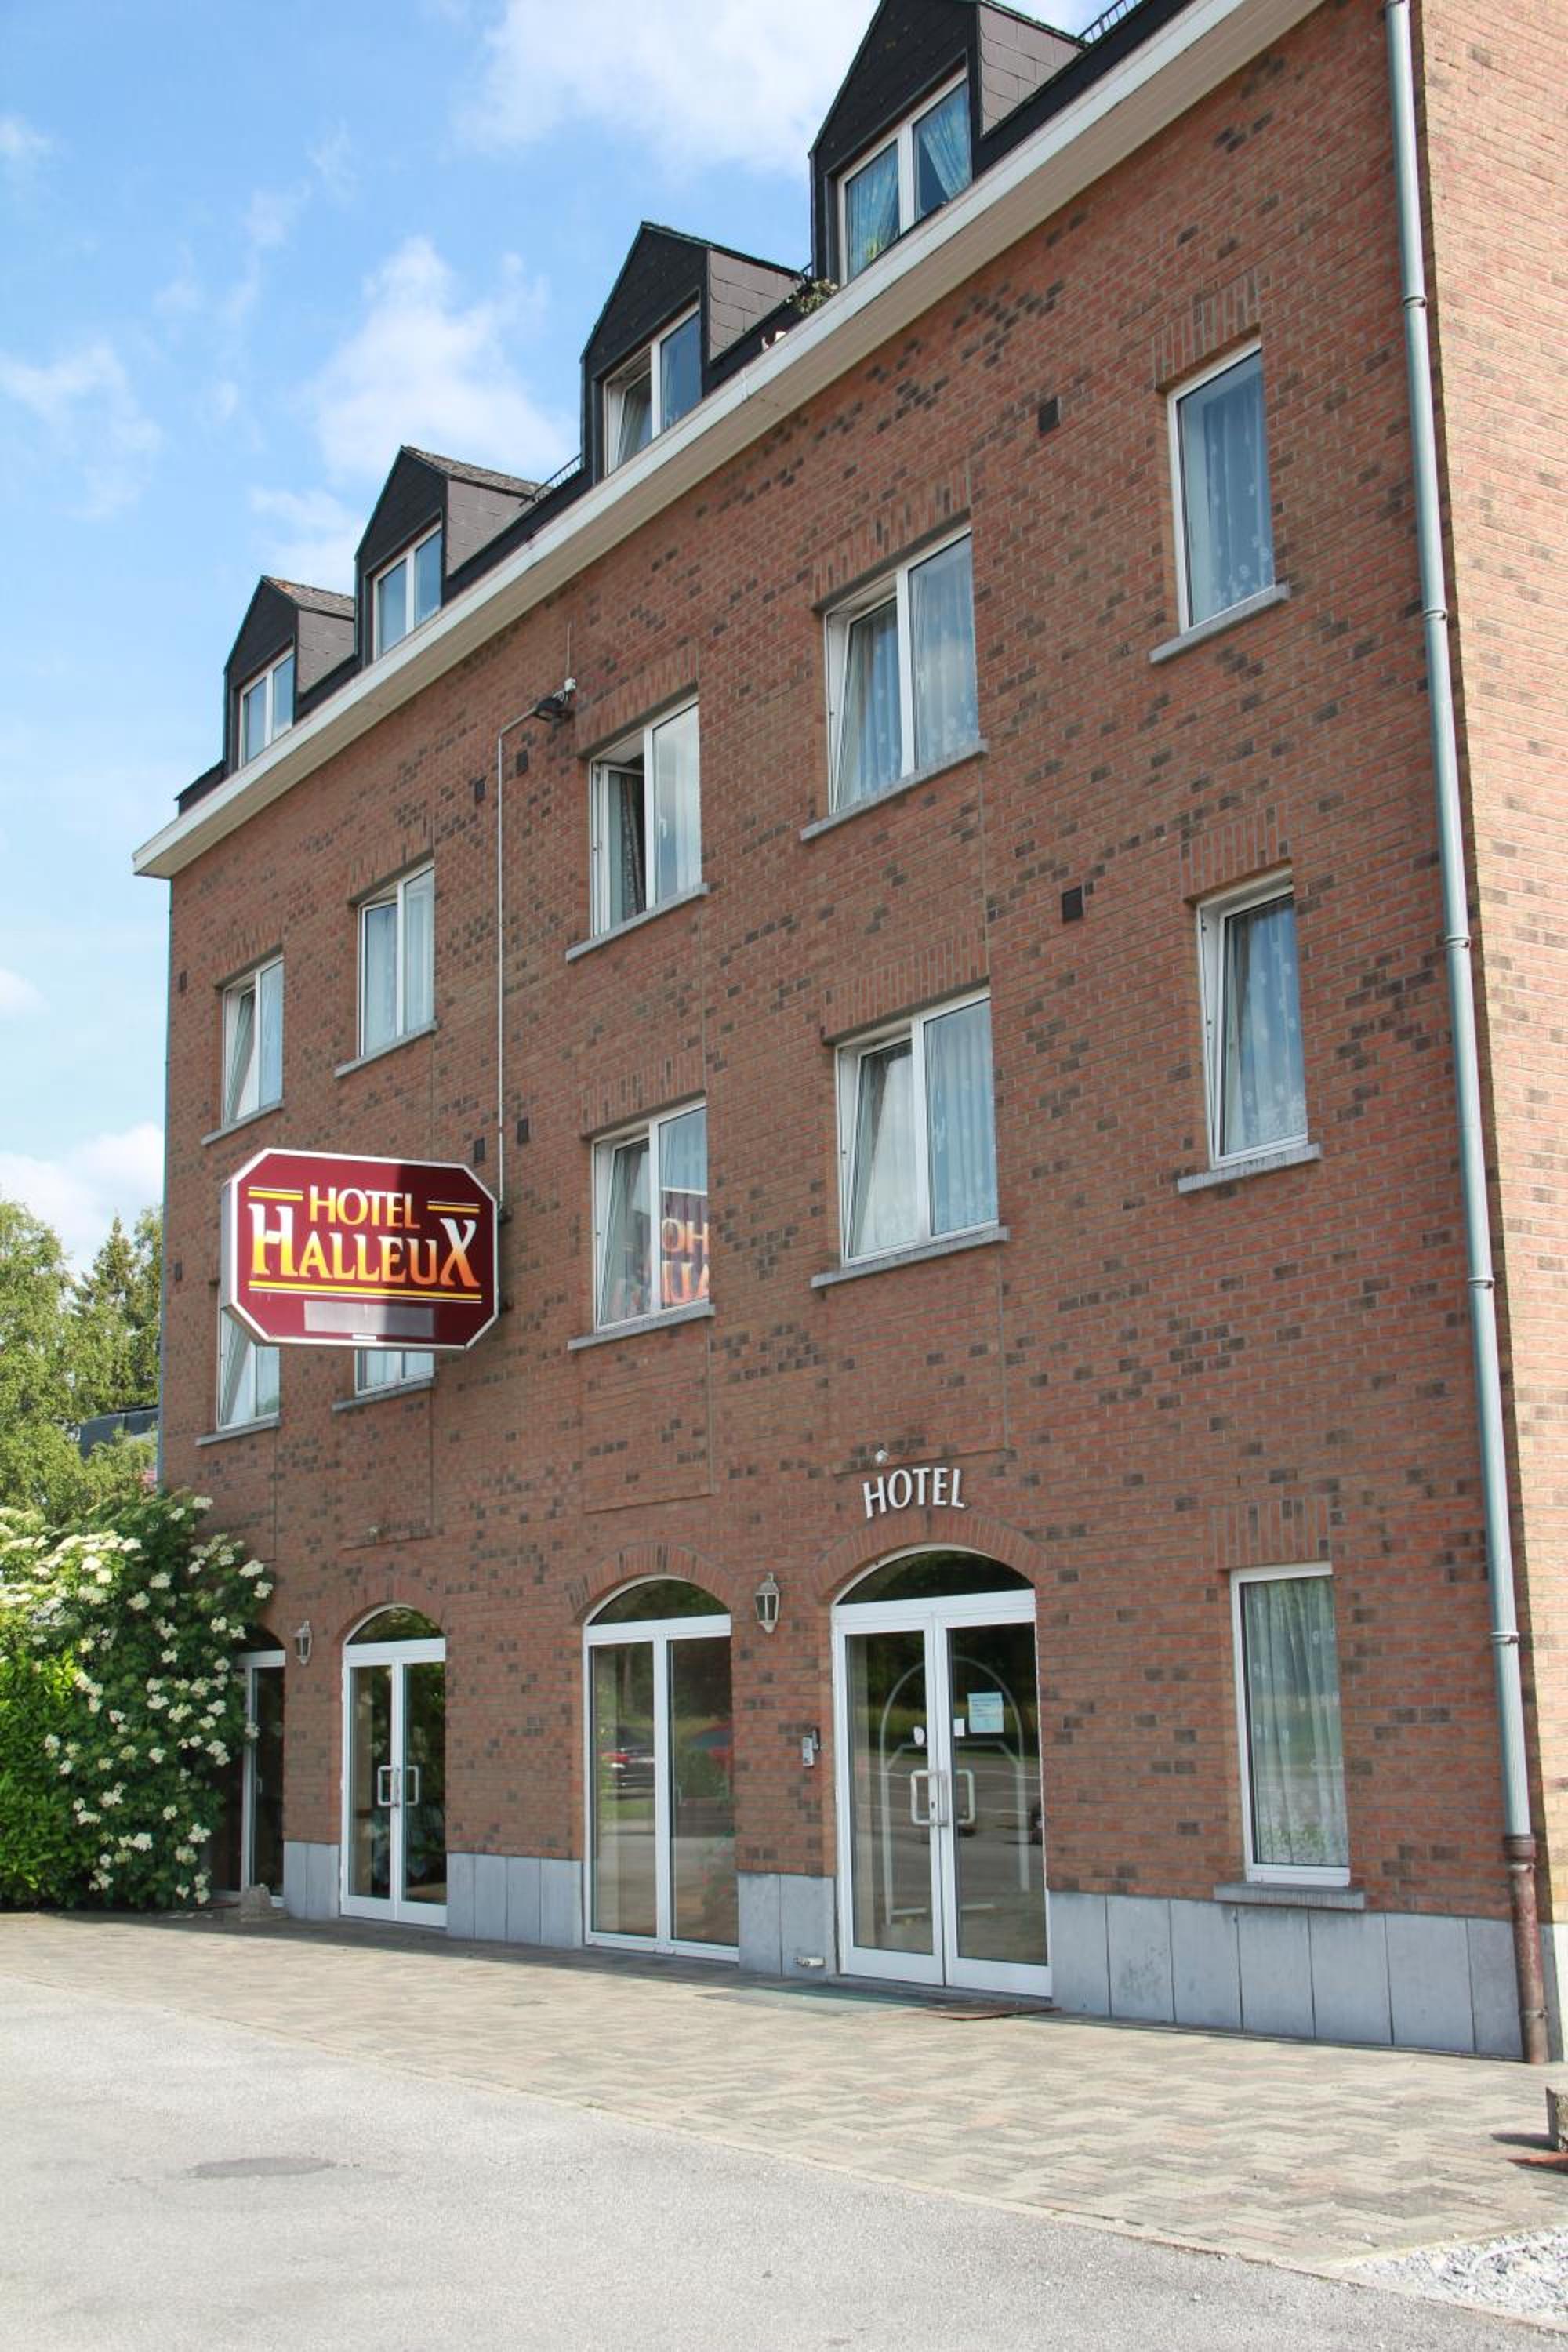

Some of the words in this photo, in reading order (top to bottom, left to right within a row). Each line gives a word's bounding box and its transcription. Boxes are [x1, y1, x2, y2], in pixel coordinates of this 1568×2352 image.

[309, 1185, 421, 1229] HOTEL
[247, 1202, 481, 1287] HALLEUX
[862, 1467, 966, 1519] HOTEL
